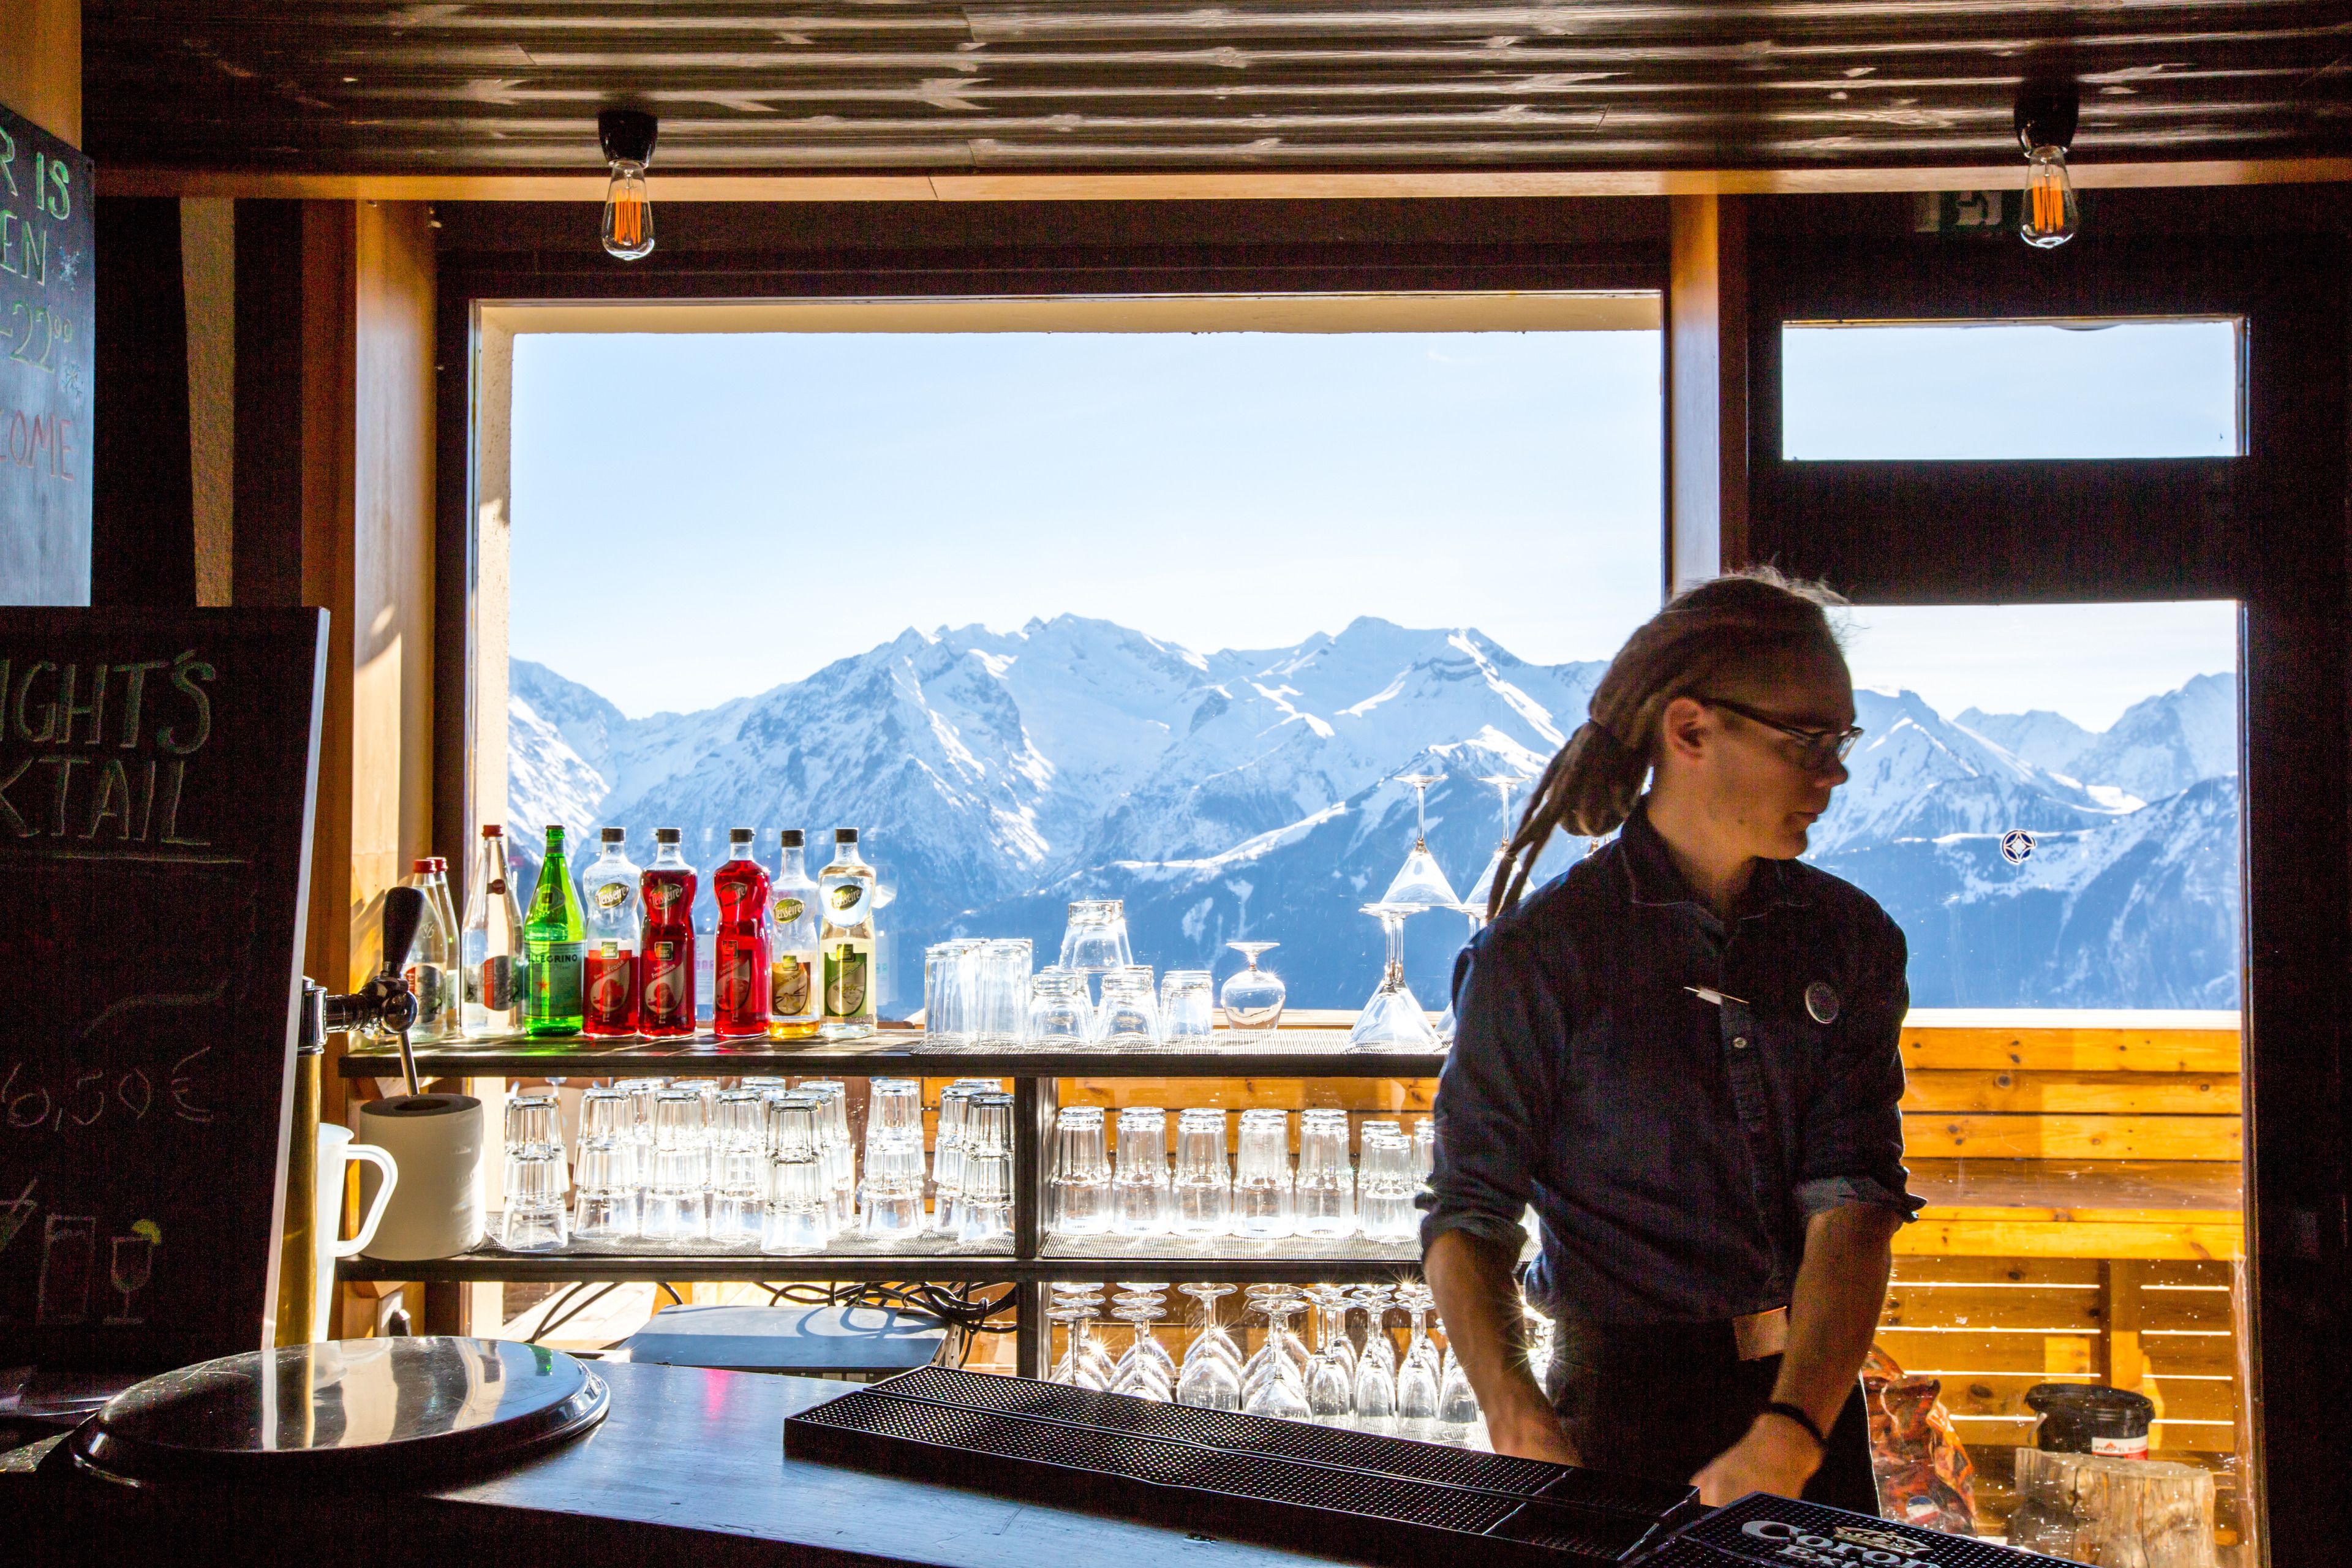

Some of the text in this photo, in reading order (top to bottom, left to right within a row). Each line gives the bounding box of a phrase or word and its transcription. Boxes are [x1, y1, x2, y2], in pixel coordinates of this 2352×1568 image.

[36, 153, 70, 220] IS
[0, 209, 46, 286] EN
[0, 410, 74, 480] OME
[597, 886, 627, 905] Teisseire
[650, 887, 681, 905] Teisseire
[774, 902, 802, 919] Teisseire
